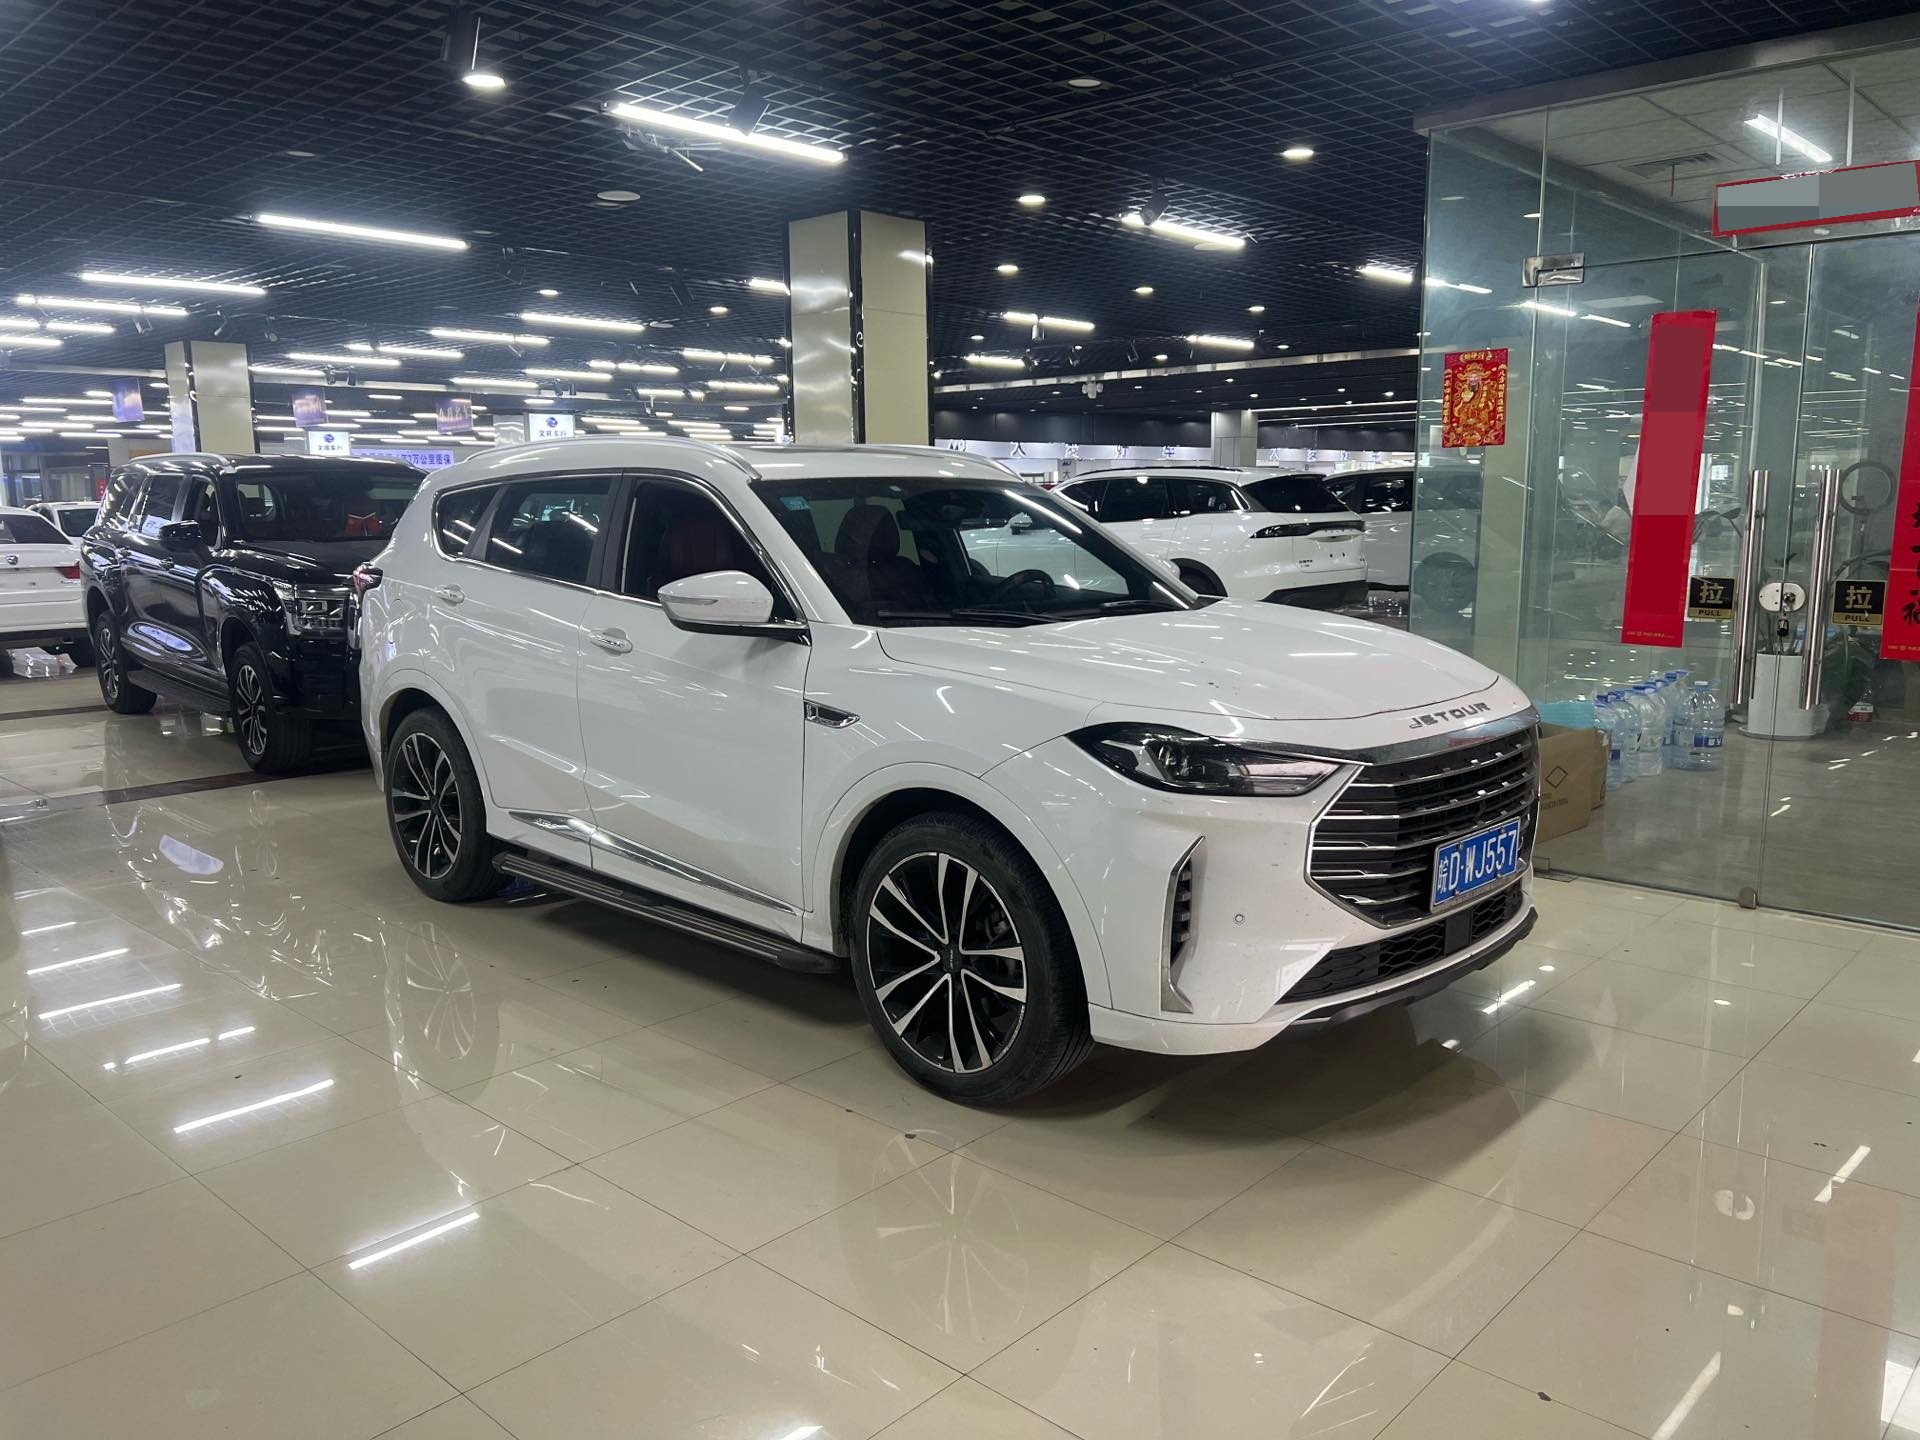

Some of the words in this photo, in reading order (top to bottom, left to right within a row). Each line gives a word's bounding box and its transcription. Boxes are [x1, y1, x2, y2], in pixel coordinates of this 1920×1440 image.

[1700, 582, 1725, 605] 拉
[1845, 585, 1873, 610] 拉
[1698, 609, 1722, 617] PULL
[1409, 702, 1491, 729] JETOUR
